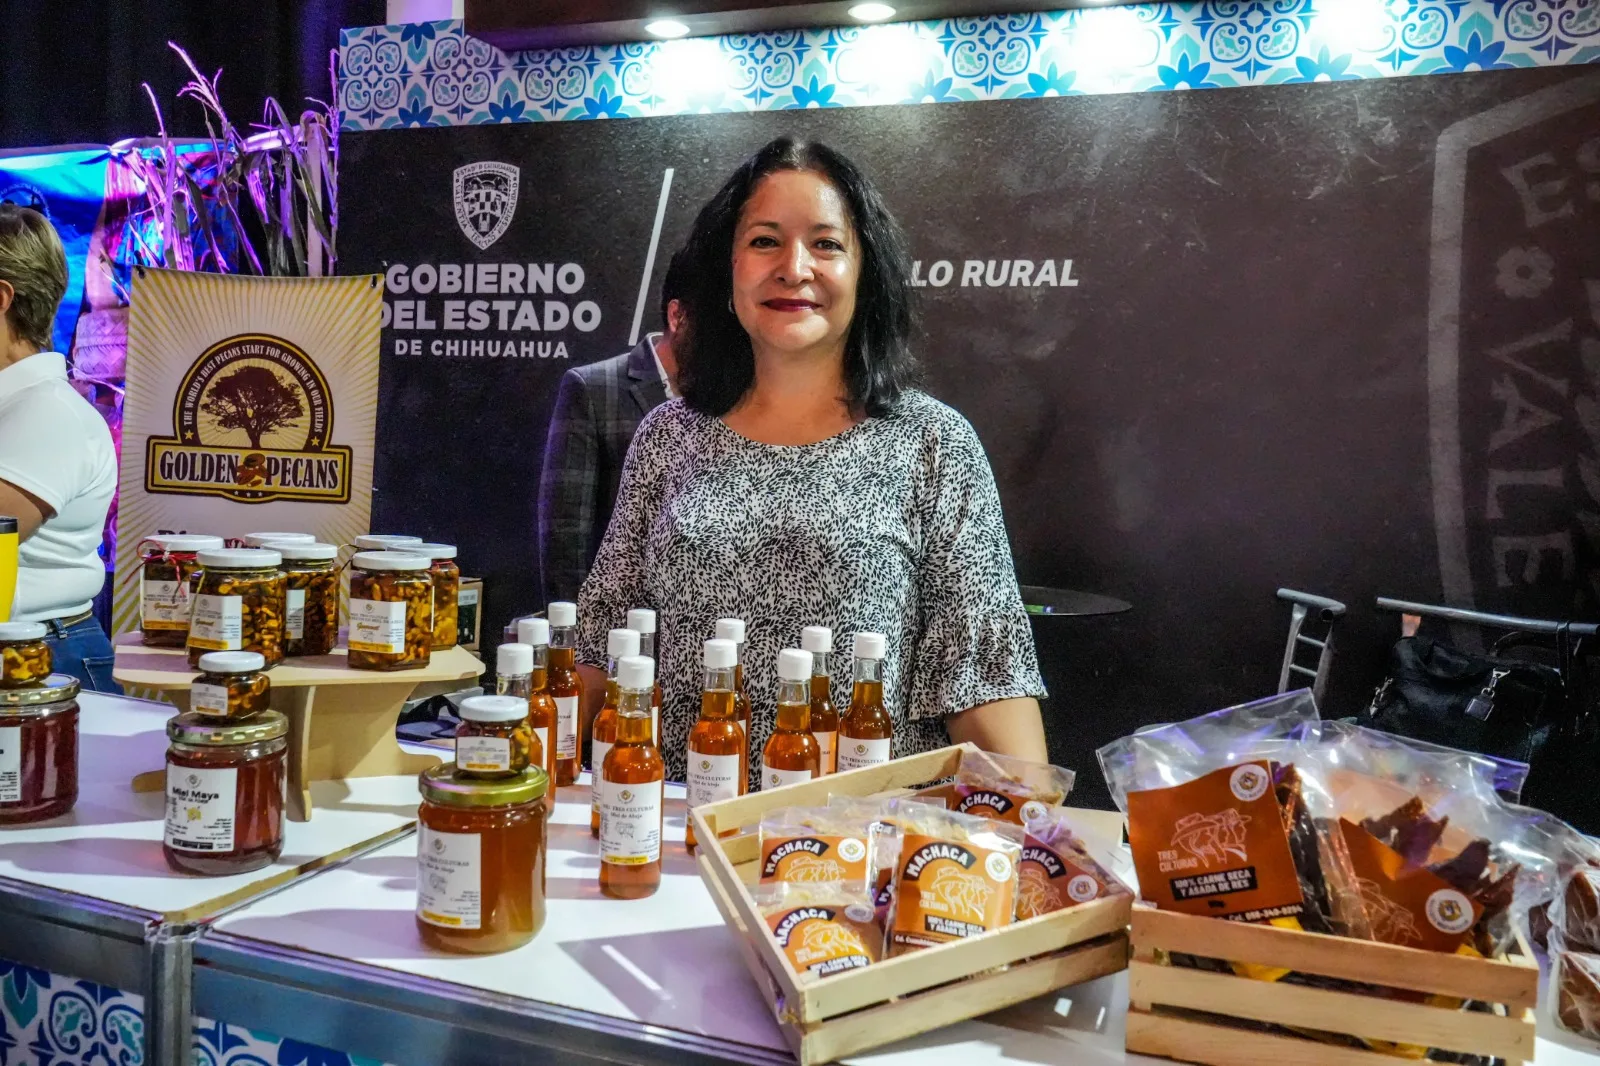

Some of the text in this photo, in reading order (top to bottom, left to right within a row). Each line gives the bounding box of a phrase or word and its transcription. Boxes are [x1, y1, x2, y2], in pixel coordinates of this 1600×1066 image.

[386, 263, 585, 294] GOBIERNO
[905, 259, 1079, 287] LO RURAL
[443, 301, 602, 332] ESTADO
[395, 340, 569, 358] DE CHIHUAHUA
[183, 345, 324, 433] THE WORLD'S BEST PECANS START FOR GROWING IN OUR FIELDS
[160, 451, 339, 489] GOLDEN PECANS
[173, 786, 189, 797] Miel
[191, 790, 219, 800] Maya
[960, 793, 1006, 814] ACHACA
[765, 840, 821, 874] MACHACA
[906, 844, 969, 878] MACHACA
[1022, 849, 1060, 875] CHACA
[1157, 850, 1178, 860] TRES
[1159, 857, 1198, 873] CULTURAS
[1180, 879, 1250, 898] Y ASADA DE RES
[1197, 873, 1226, 886] CARNE
[1227, 869, 1251, 882] SECA
[775, 908, 828, 946] MACHACA
